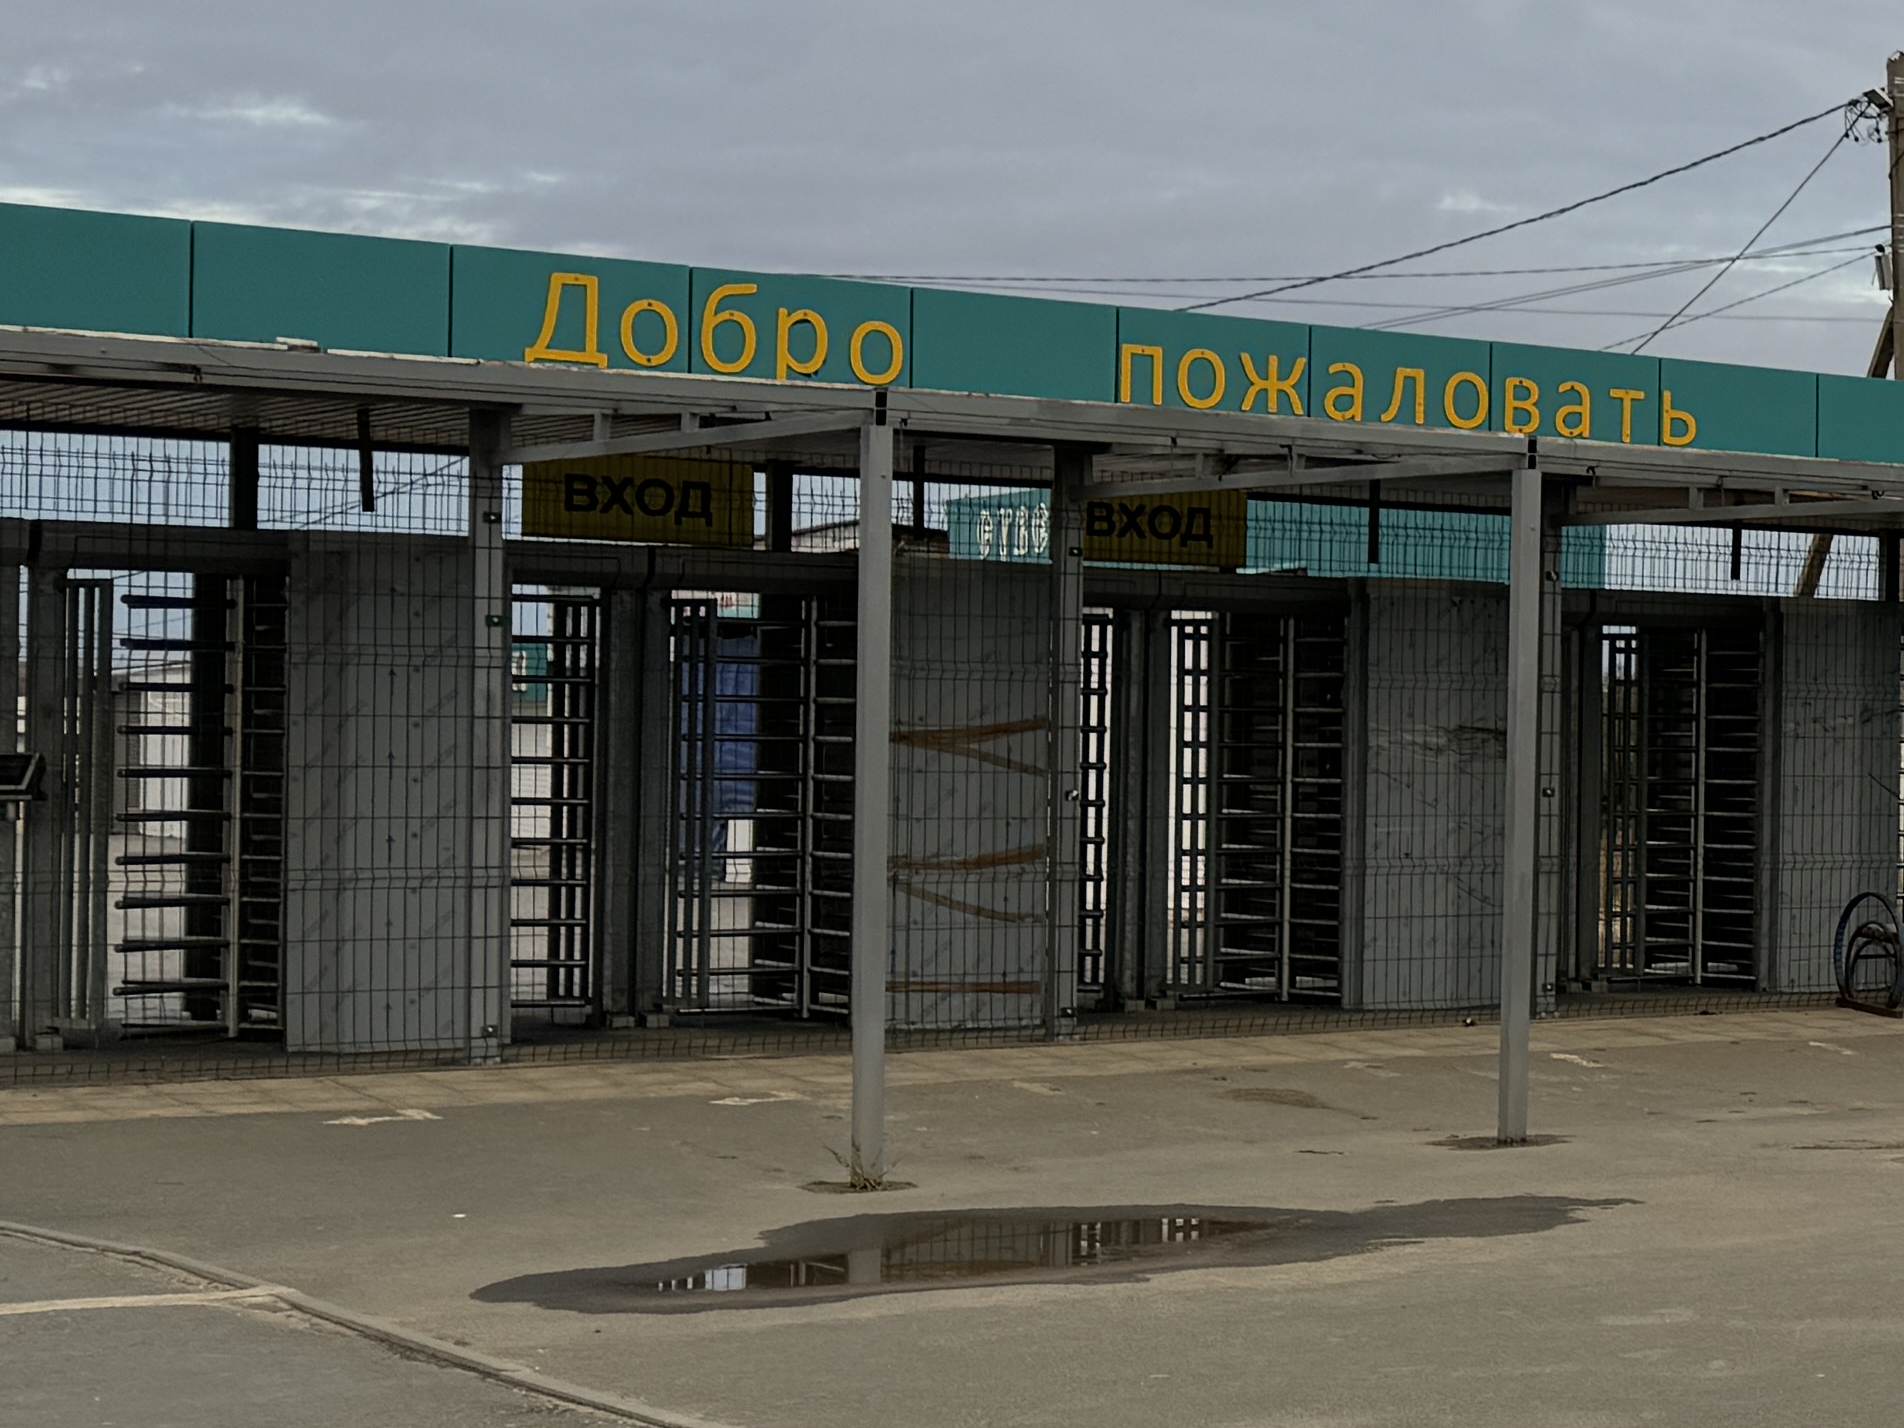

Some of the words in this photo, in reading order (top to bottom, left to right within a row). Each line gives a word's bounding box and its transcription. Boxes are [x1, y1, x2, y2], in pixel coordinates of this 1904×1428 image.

[525, 272, 903, 385] Добро
[1120, 343, 1697, 445] пожаловать
[564, 474, 714, 528] ВХОД
[1085, 500, 1214, 549] ВХОД
